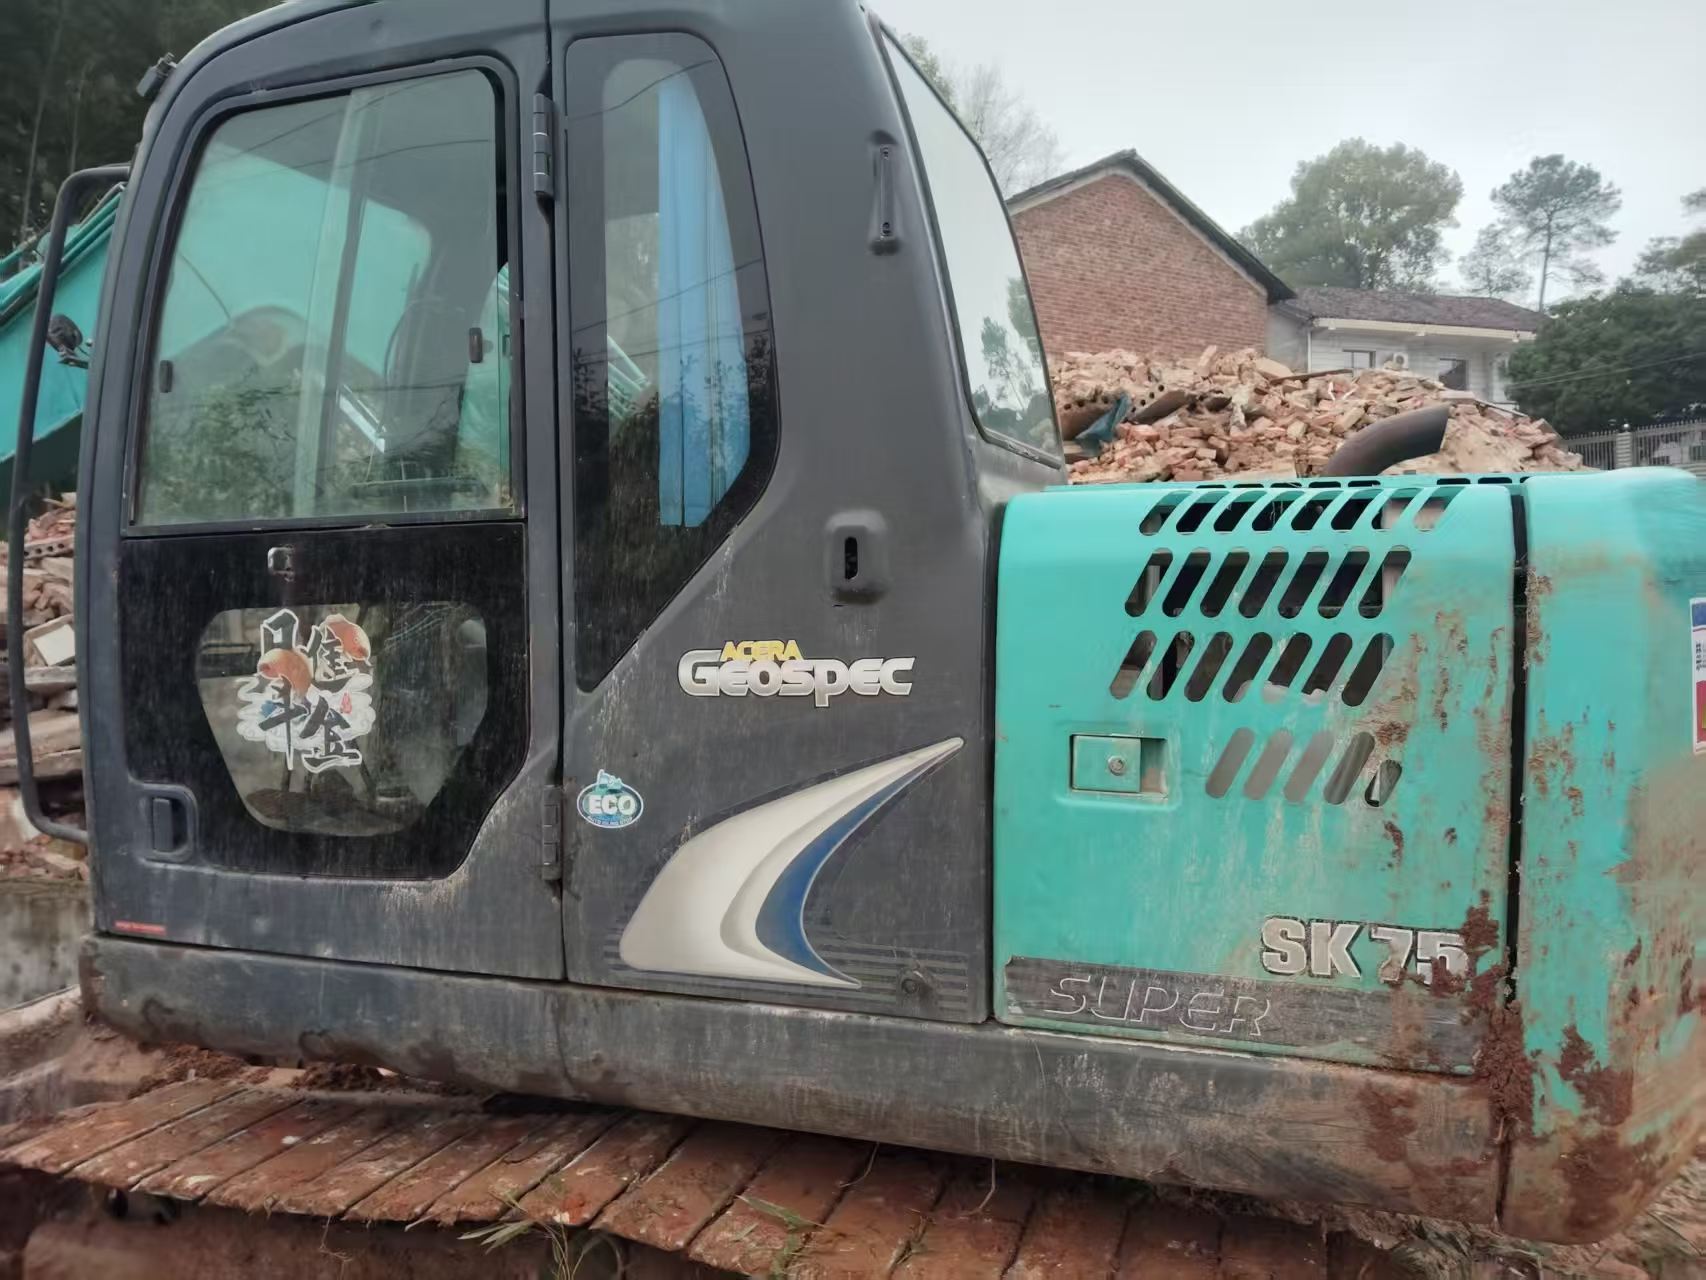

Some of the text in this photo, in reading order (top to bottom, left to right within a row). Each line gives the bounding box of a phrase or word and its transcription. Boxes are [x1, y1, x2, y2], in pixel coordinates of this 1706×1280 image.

[720, 640, 804, 661] ACERA
[589, 795, 636, 816] ECO
[1044, 973, 1271, 1037] SUPER
